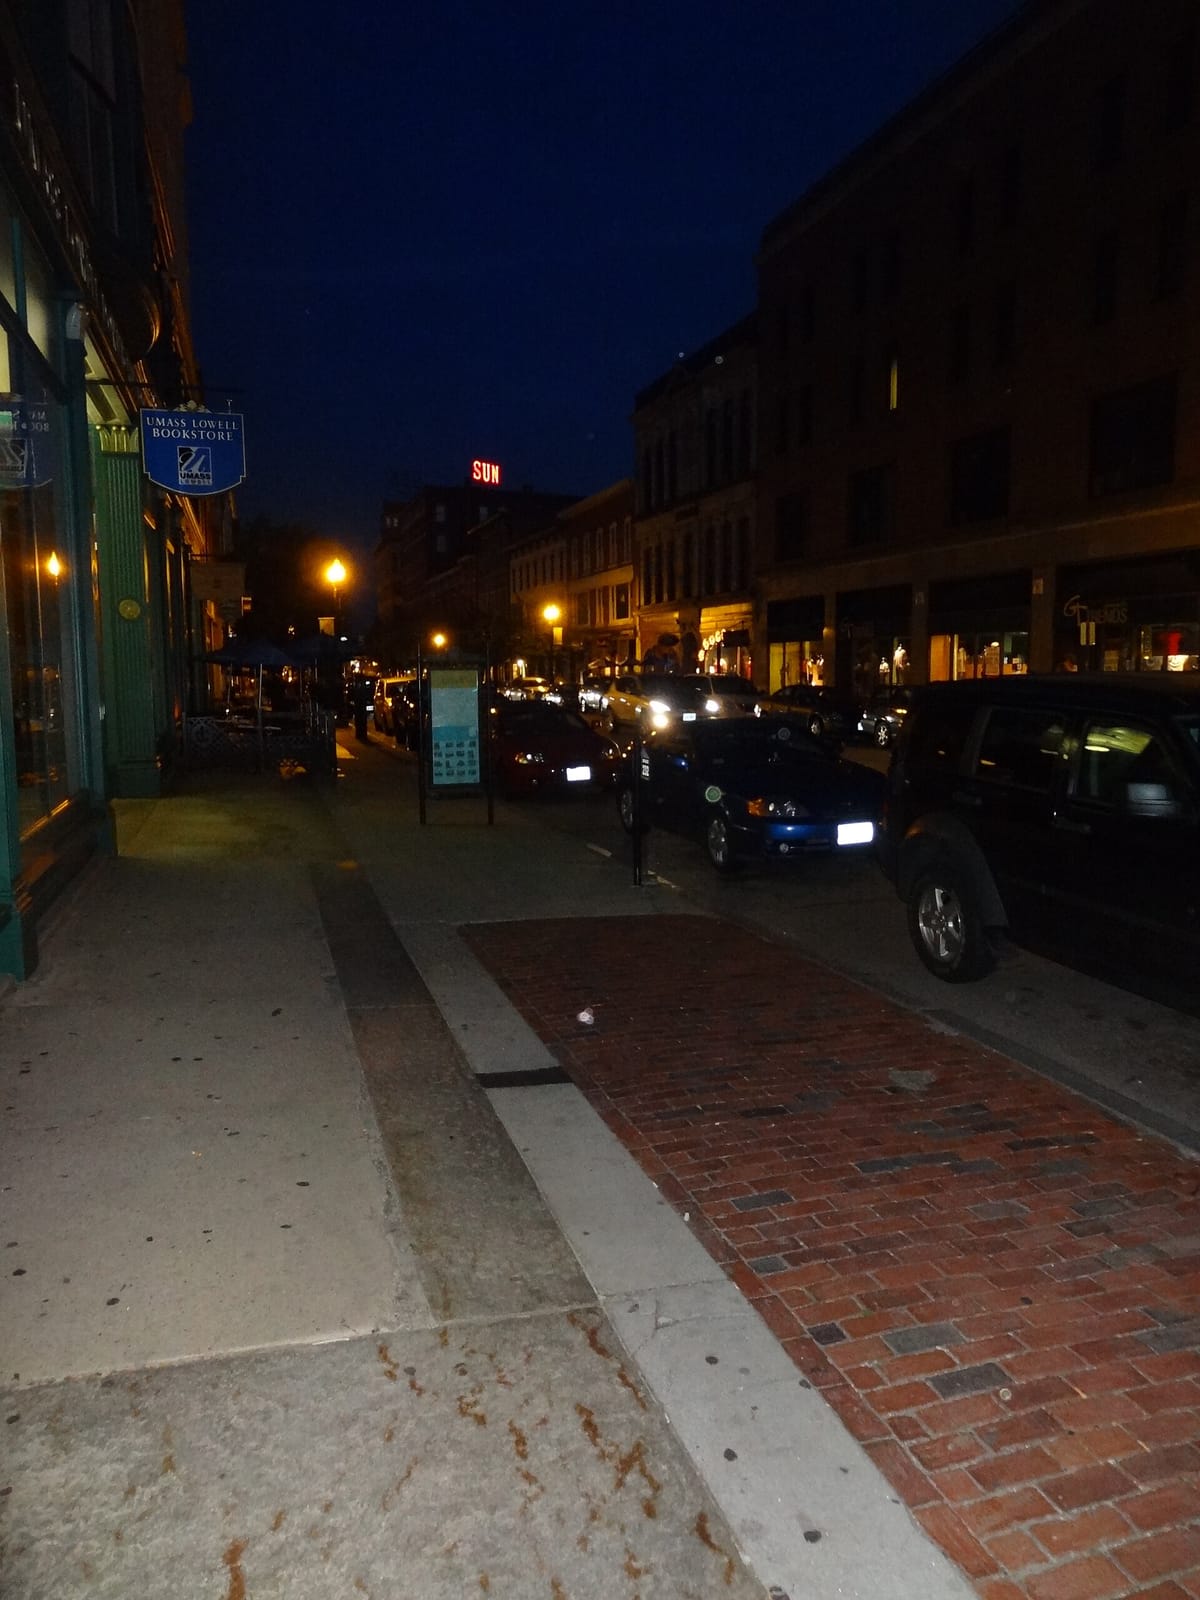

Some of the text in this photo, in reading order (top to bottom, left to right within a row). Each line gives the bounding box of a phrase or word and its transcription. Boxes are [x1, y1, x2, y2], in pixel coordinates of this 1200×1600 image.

[146, 416, 239, 430] UMASS LOWELL
[152, 428, 234, 441] BOOKSTORE
[180, 472, 211, 480] UMASS
[472, 459, 500, 484] SUN
